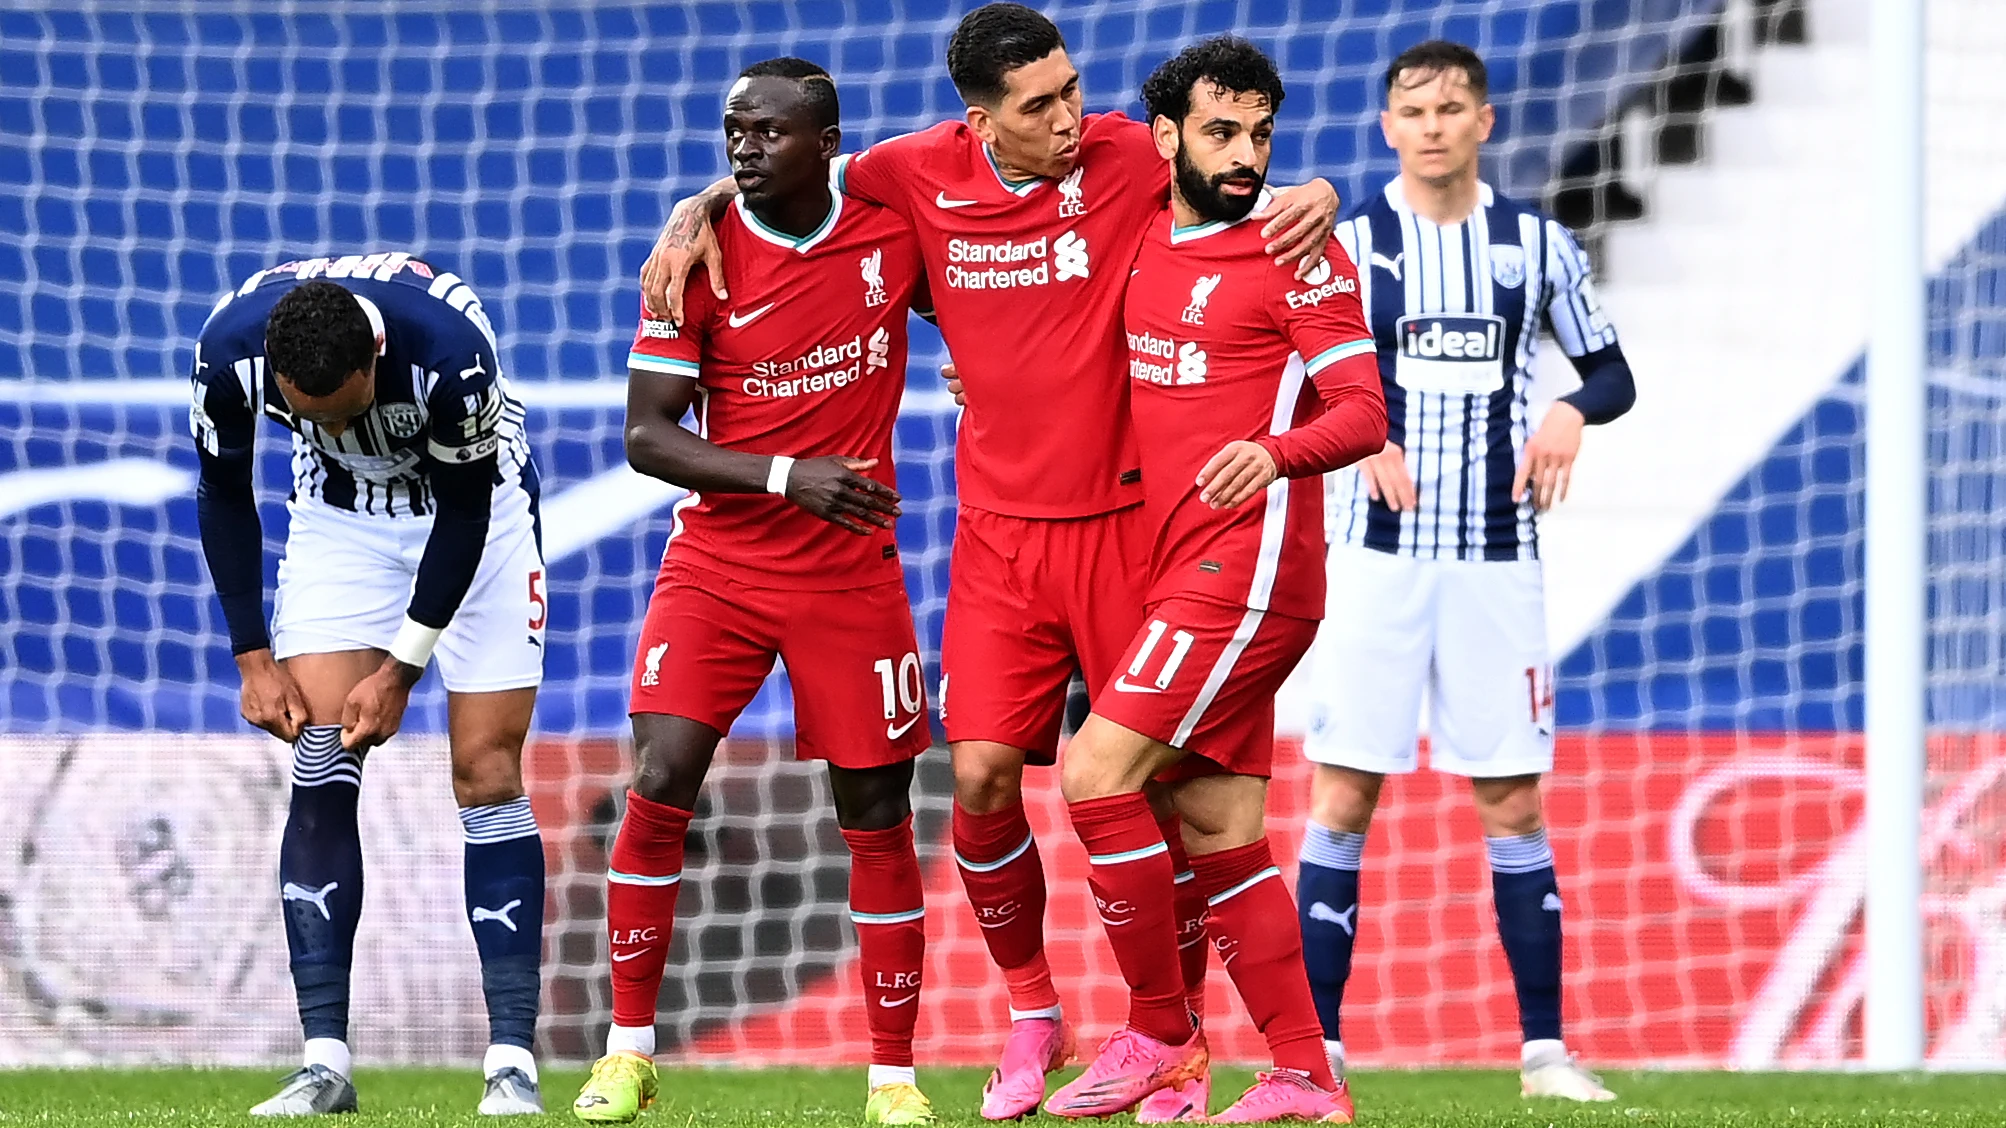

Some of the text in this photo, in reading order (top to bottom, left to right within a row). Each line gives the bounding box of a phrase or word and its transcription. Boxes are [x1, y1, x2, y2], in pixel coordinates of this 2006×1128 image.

[948, 236, 1048, 263] Standard
[945, 261, 1049, 289] Chartered
[1285, 275, 1356, 309] Expedia
[752, 335, 862, 378] Standard
[1126, 330, 1175, 359] andard
[1407, 322, 1497, 358] ideal
[742, 360, 860, 398] Chartered
[1129, 357, 1174, 386] rtered
[475, 440, 496, 455] Ca
[528, 569, 545, 631] 5
[1127, 619, 1195, 690] 11
[873, 652, 922, 719] 10
